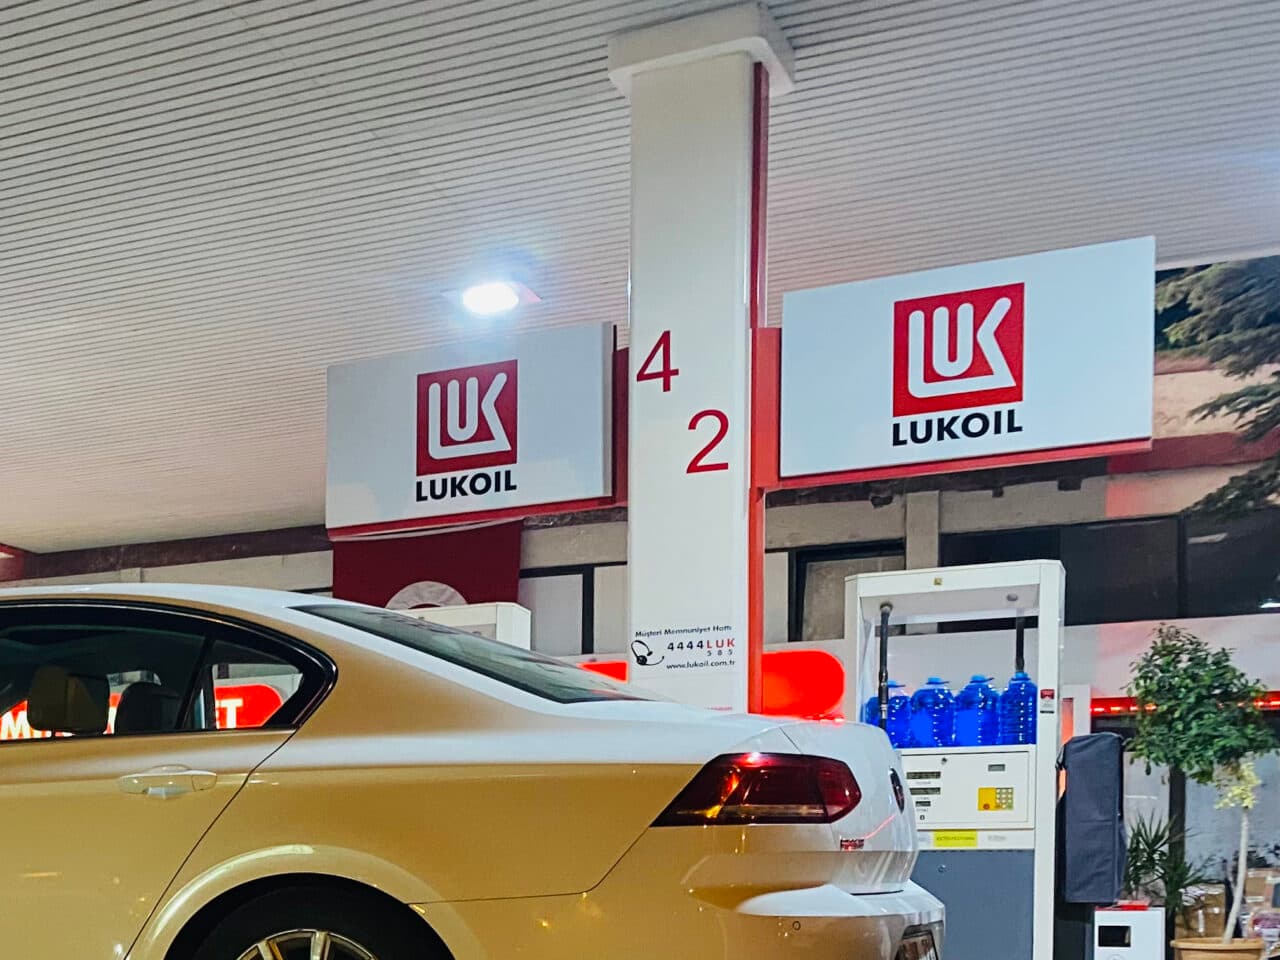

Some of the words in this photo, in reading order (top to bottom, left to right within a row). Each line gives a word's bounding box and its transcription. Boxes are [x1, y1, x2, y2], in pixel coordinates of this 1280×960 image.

[636, 330, 680, 393] 4
[907, 297, 1018, 398] LUK
[428, 372, 512, 460] LUK
[686, 409, 730, 474] 2
[892, 408, 1024, 447] LUKOIL
[415, 469, 518, 502] LUKOIL
